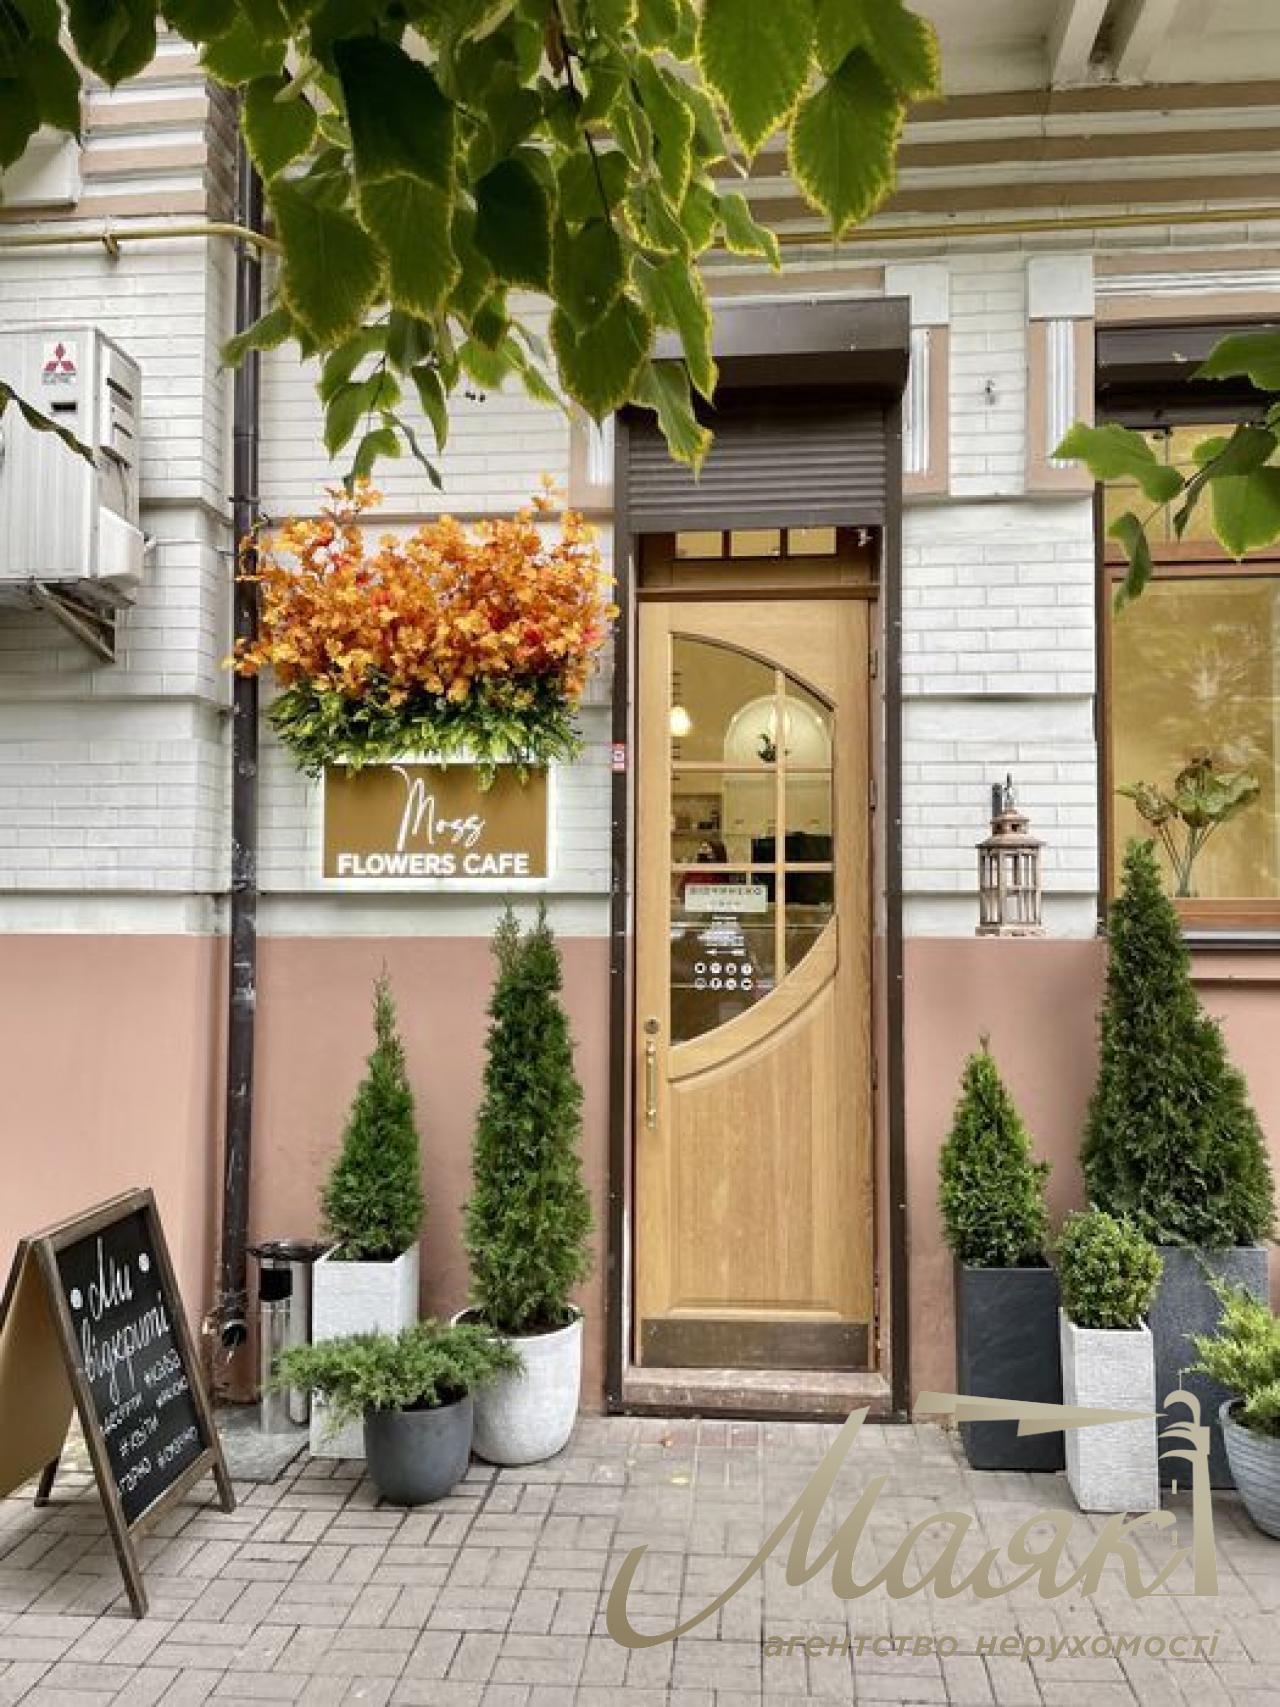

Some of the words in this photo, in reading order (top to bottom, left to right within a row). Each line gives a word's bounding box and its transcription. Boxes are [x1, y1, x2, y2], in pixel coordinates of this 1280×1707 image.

[391, 765, 485, 851] Moss
[338, 853, 456, 875] FLOWERS
[463, 853, 530, 875] CAFE
